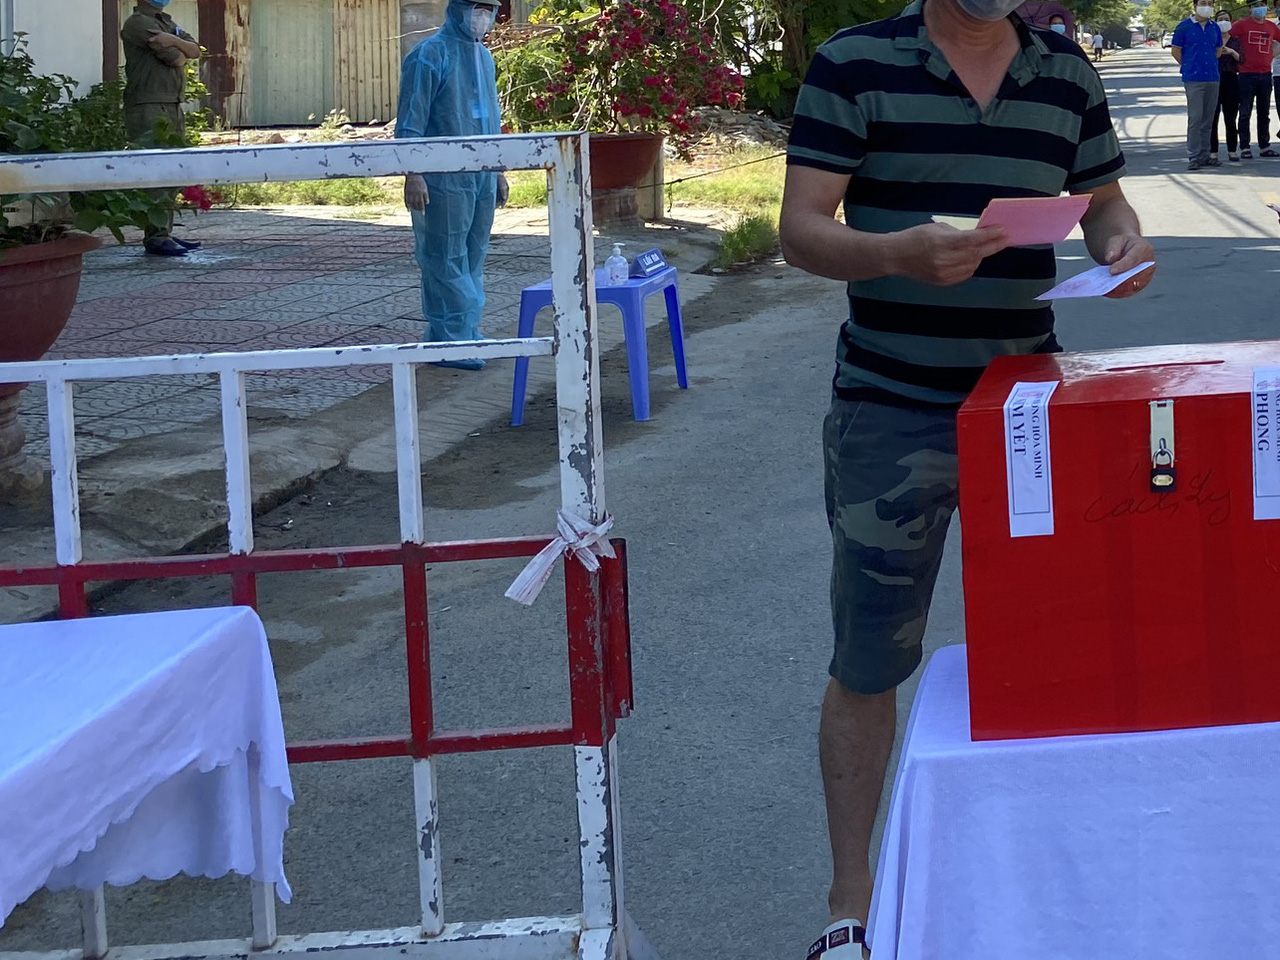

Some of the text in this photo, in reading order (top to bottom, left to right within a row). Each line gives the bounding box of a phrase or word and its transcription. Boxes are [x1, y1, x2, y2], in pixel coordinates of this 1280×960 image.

[1032, 425, 1043, 448] HÒA
[1256, 393, 1270, 452] PHONG
[1012, 422, 1030, 456] YẾT
[1033, 450, 1043, 479] MINH
